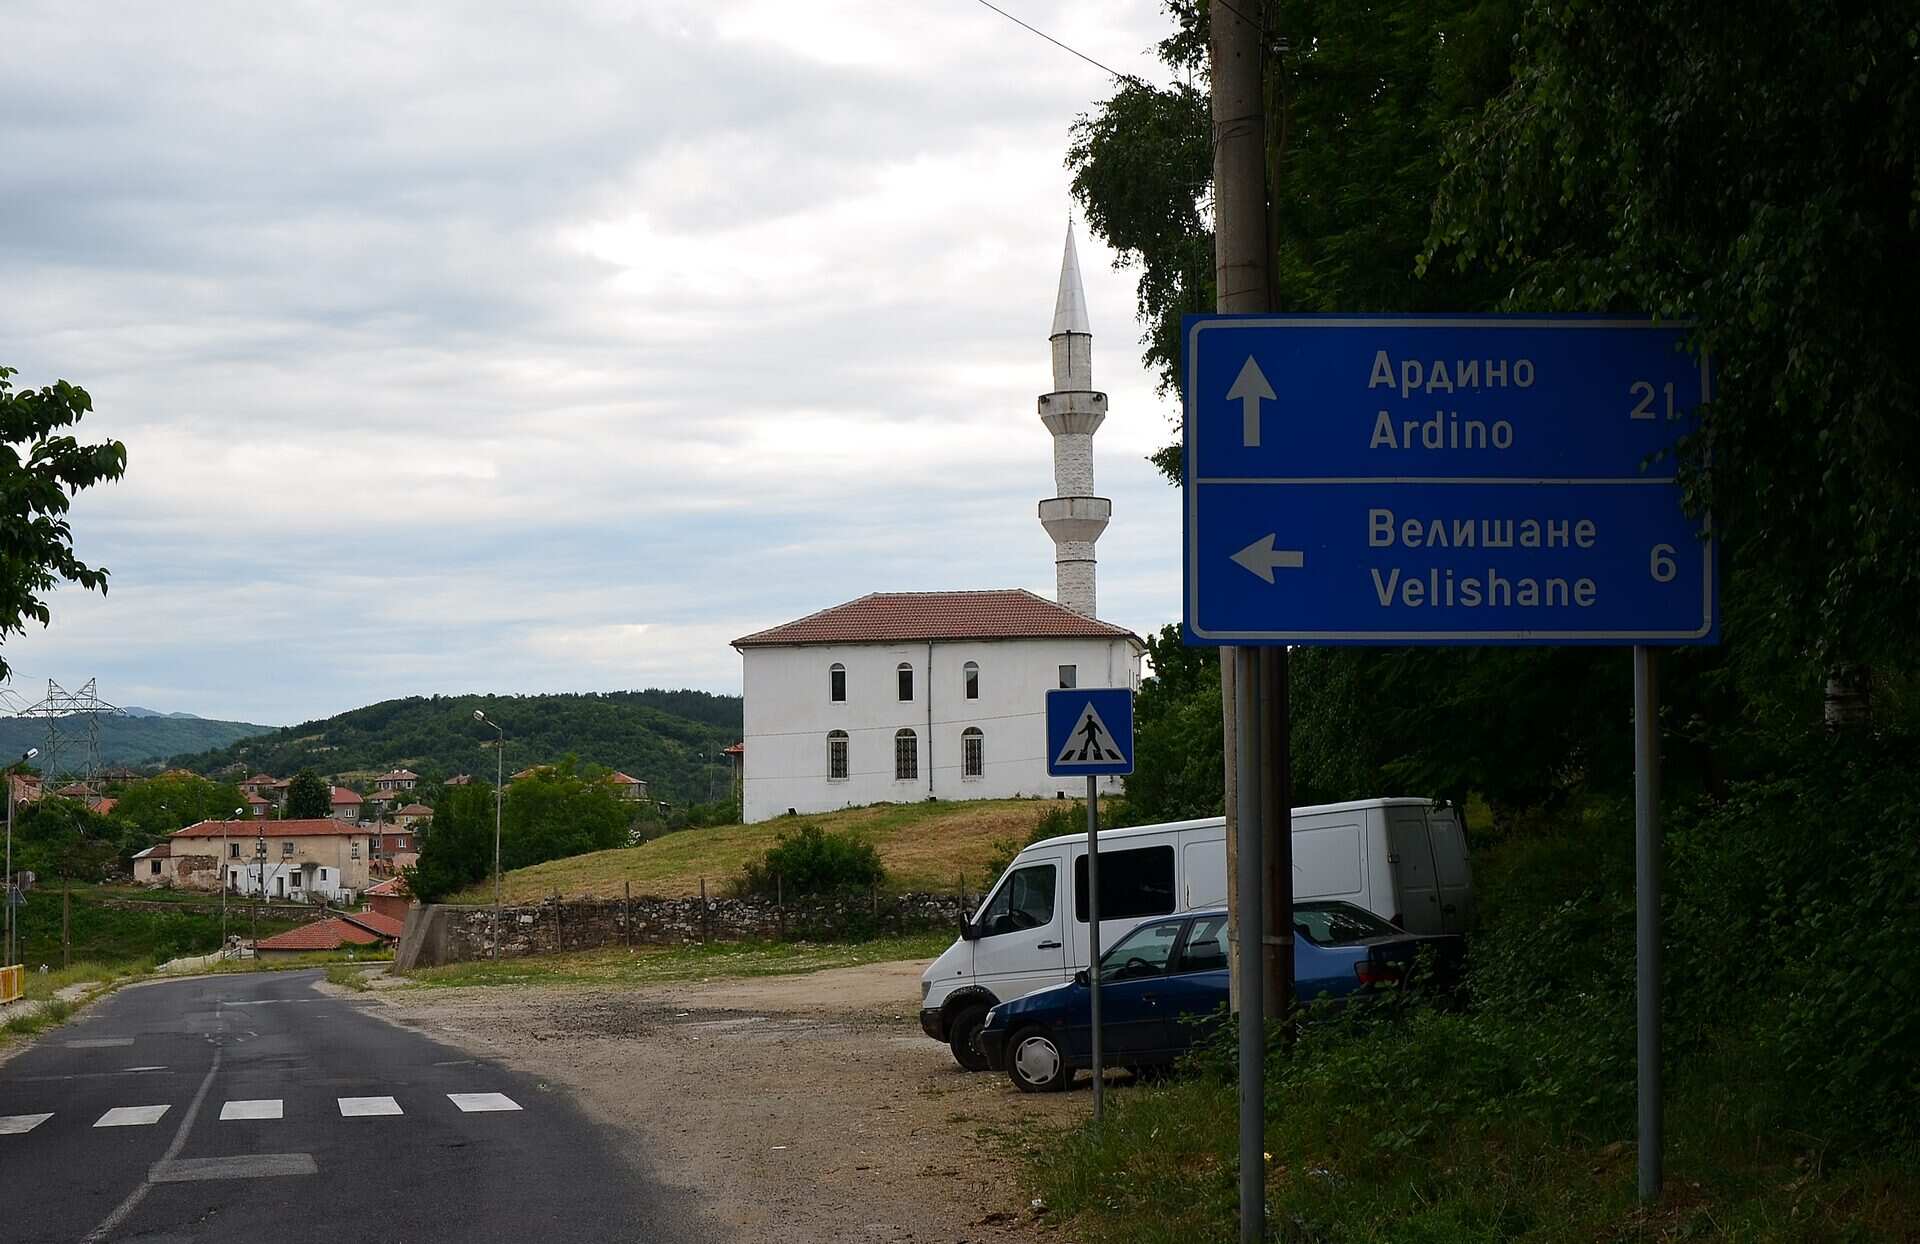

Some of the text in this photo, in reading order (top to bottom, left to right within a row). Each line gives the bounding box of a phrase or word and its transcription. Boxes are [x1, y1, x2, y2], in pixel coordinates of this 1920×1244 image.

[1368, 350, 1535, 399] Ардино
[1630, 381, 1674, 420] 21
[1370, 410, 1513, 449] Ardino
[1368, 508, 1596, 548] Велишане
[1650, 543, 1677, 583] 6
[1370, 568, 1596, 607] Velishane
